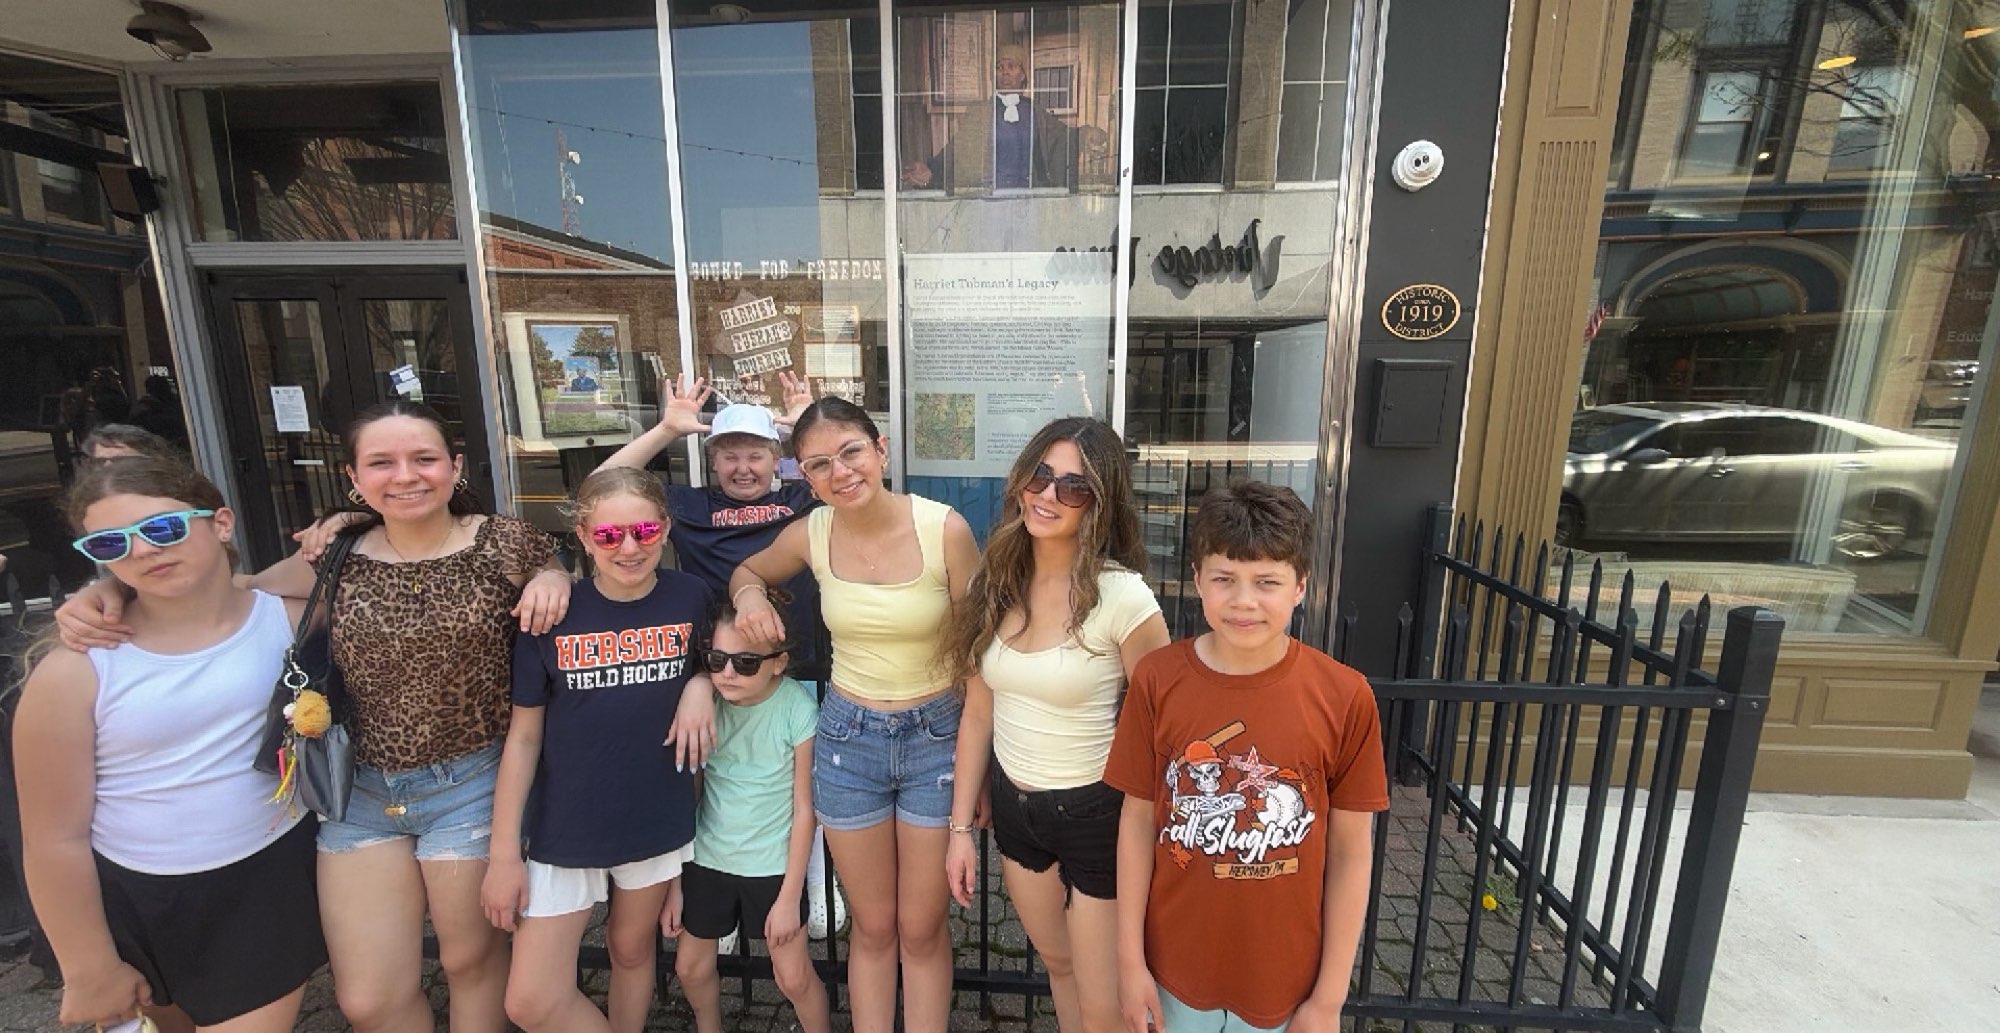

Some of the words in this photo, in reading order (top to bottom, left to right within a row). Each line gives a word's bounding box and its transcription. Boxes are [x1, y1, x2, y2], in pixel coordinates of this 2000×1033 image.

[691, 261, 743, 281] BOUND
[760, 259, 788, 280] FOR
[807, 259, 882, 280] FREEDOM
[914, 279, 955, 290] Harriet
[958, 277, 1013, 289] Tubman's
[1018, 278, 1059, 293] Legacy
[1395, 288, 1450, 305] HISTORIC
[721, 298, 777, 329] HARRIET
[1401, 304, 1443, 322] 1919
[732, 321, 791, 352] TUBMAN'S
[1395, 322, 1443, 337] DISTRICT
[735, 349, 792, 376] JOURNEY
[555, 622, 693, 670] HERSHEY
[566, 668, 619, 690] FIELD
[622, 659, 686, 686] HOCKEY
[1202, 810, 1316, 864] Slugfest
